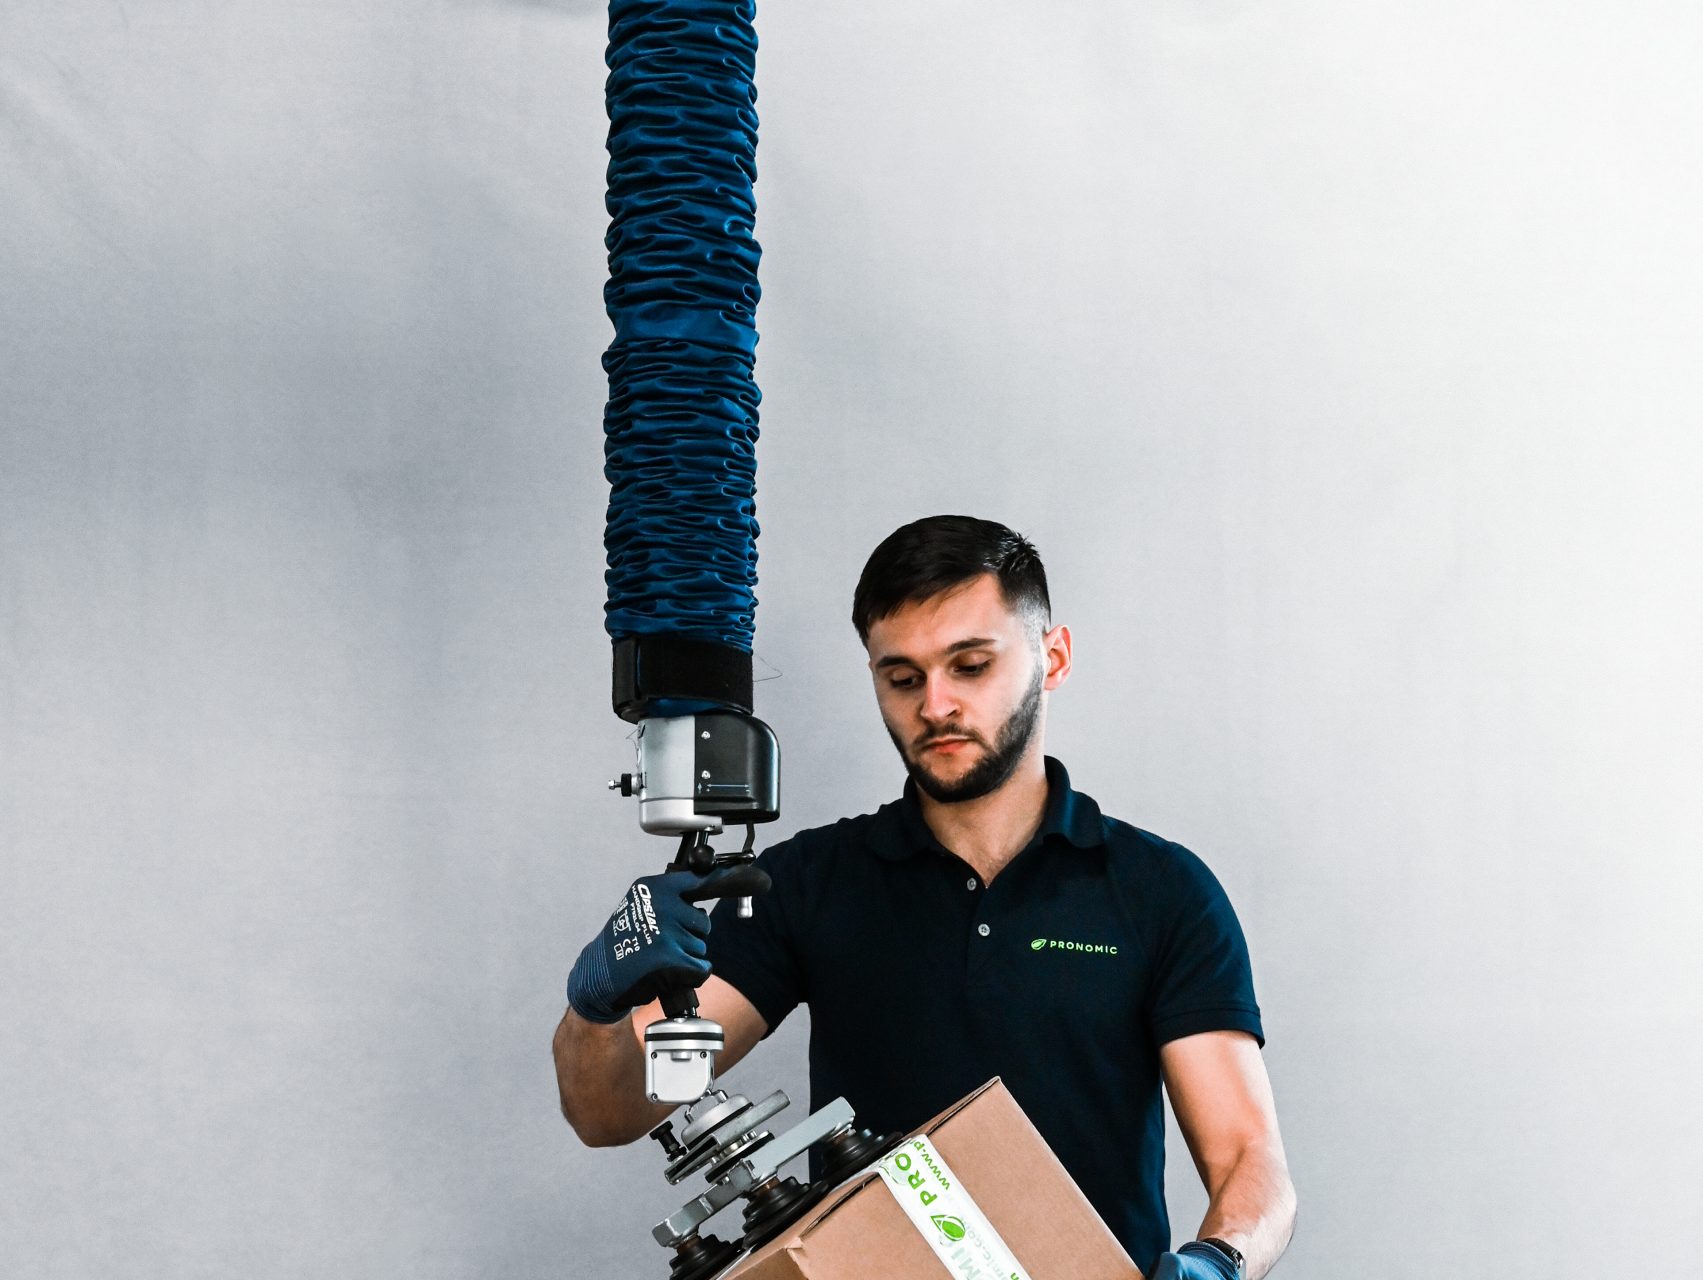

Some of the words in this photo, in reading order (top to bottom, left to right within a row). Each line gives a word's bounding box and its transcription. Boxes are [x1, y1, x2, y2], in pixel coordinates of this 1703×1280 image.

[641, 923, 653, 945] PLUS
[1049, 940, 1118, 955] PRONOMIC
[894, 1152, 938, 1206] PRO
[909, 1140, 951, 1190] www.p
